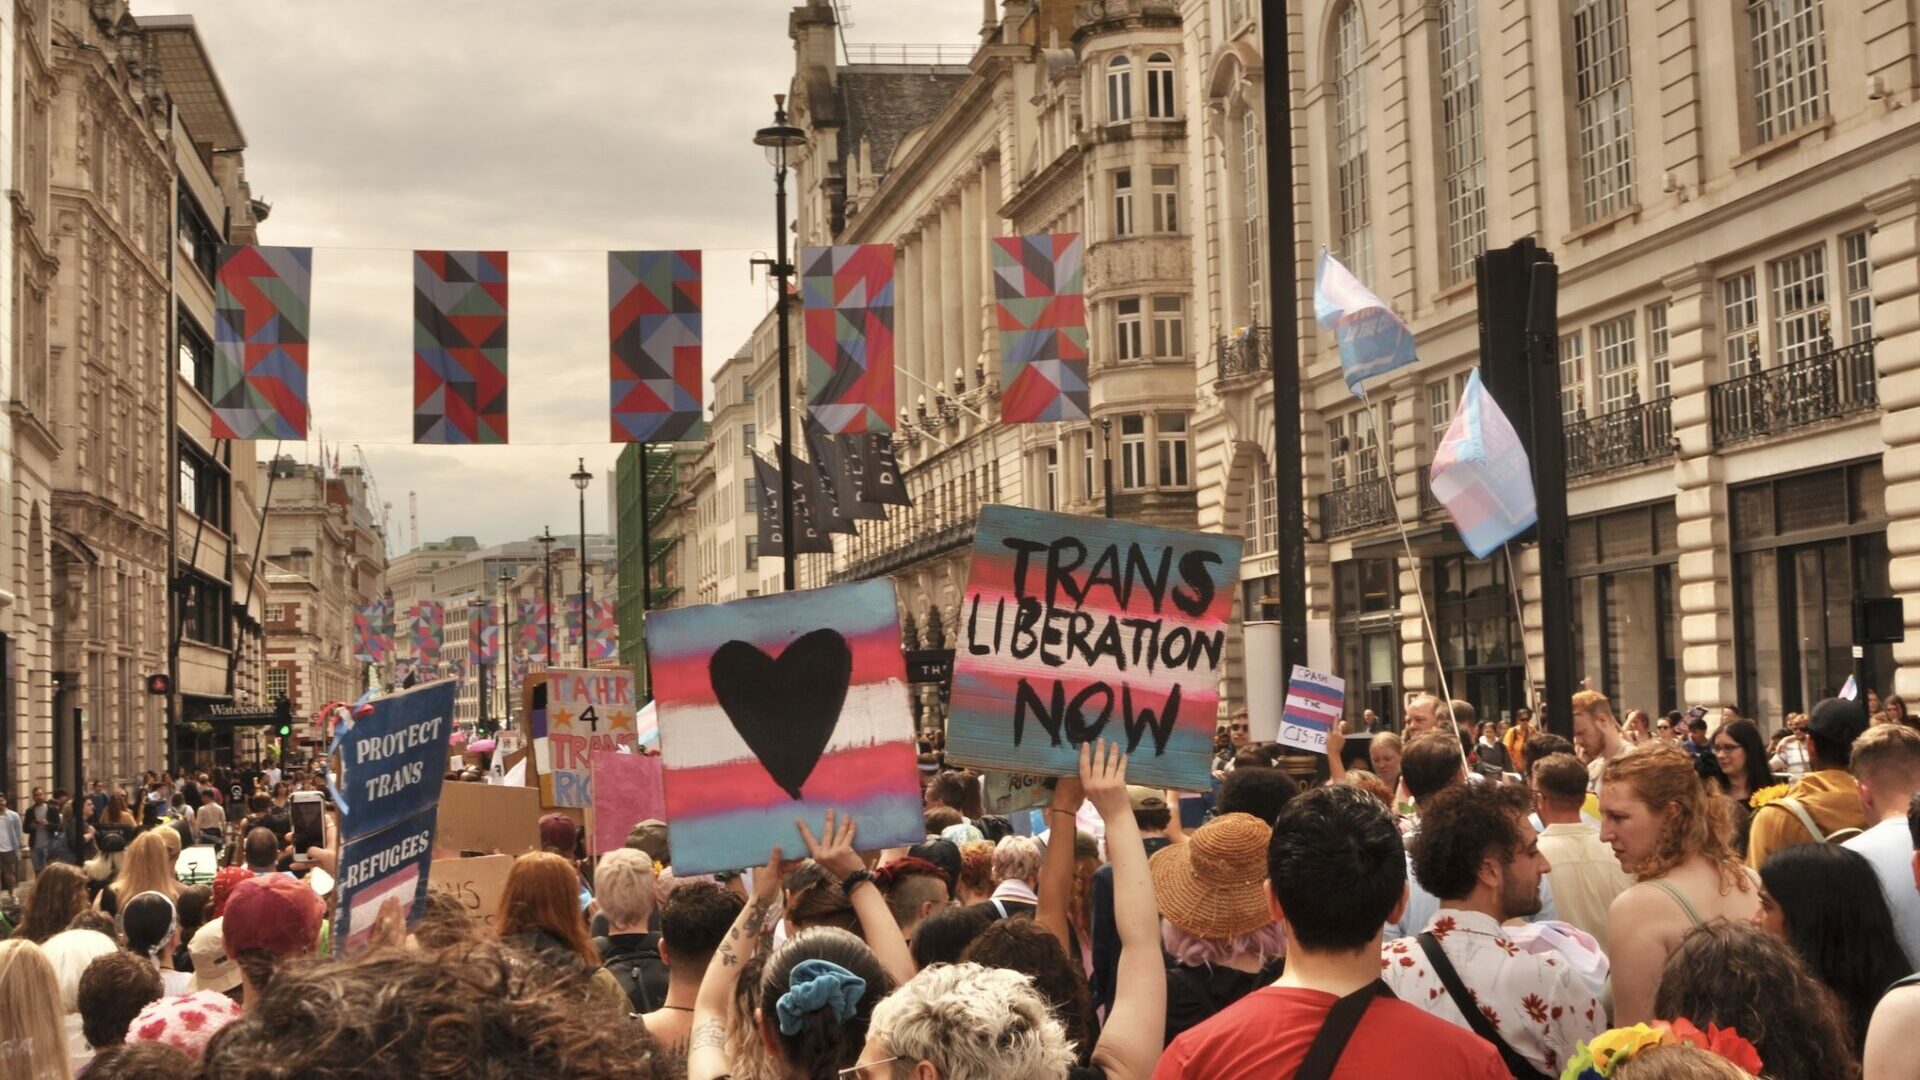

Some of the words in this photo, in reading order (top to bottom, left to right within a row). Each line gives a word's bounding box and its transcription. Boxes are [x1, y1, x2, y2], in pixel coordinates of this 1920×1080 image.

[766, 486, 783, 543] DILLY
[1002, 536, 1223, 617] TRANS
[967, 592, 1225, 675] LIBERATION
[356, 716, 443, 765] PROTECT
[578, 705, 599, 732] 4
[1013, 677, 1182, 757] NOW
[1283, 725, 1328, 747] CIS-TE
[365, 760, 424, 802] TRANS
[345, 829, 430, 889] REFUGEES
